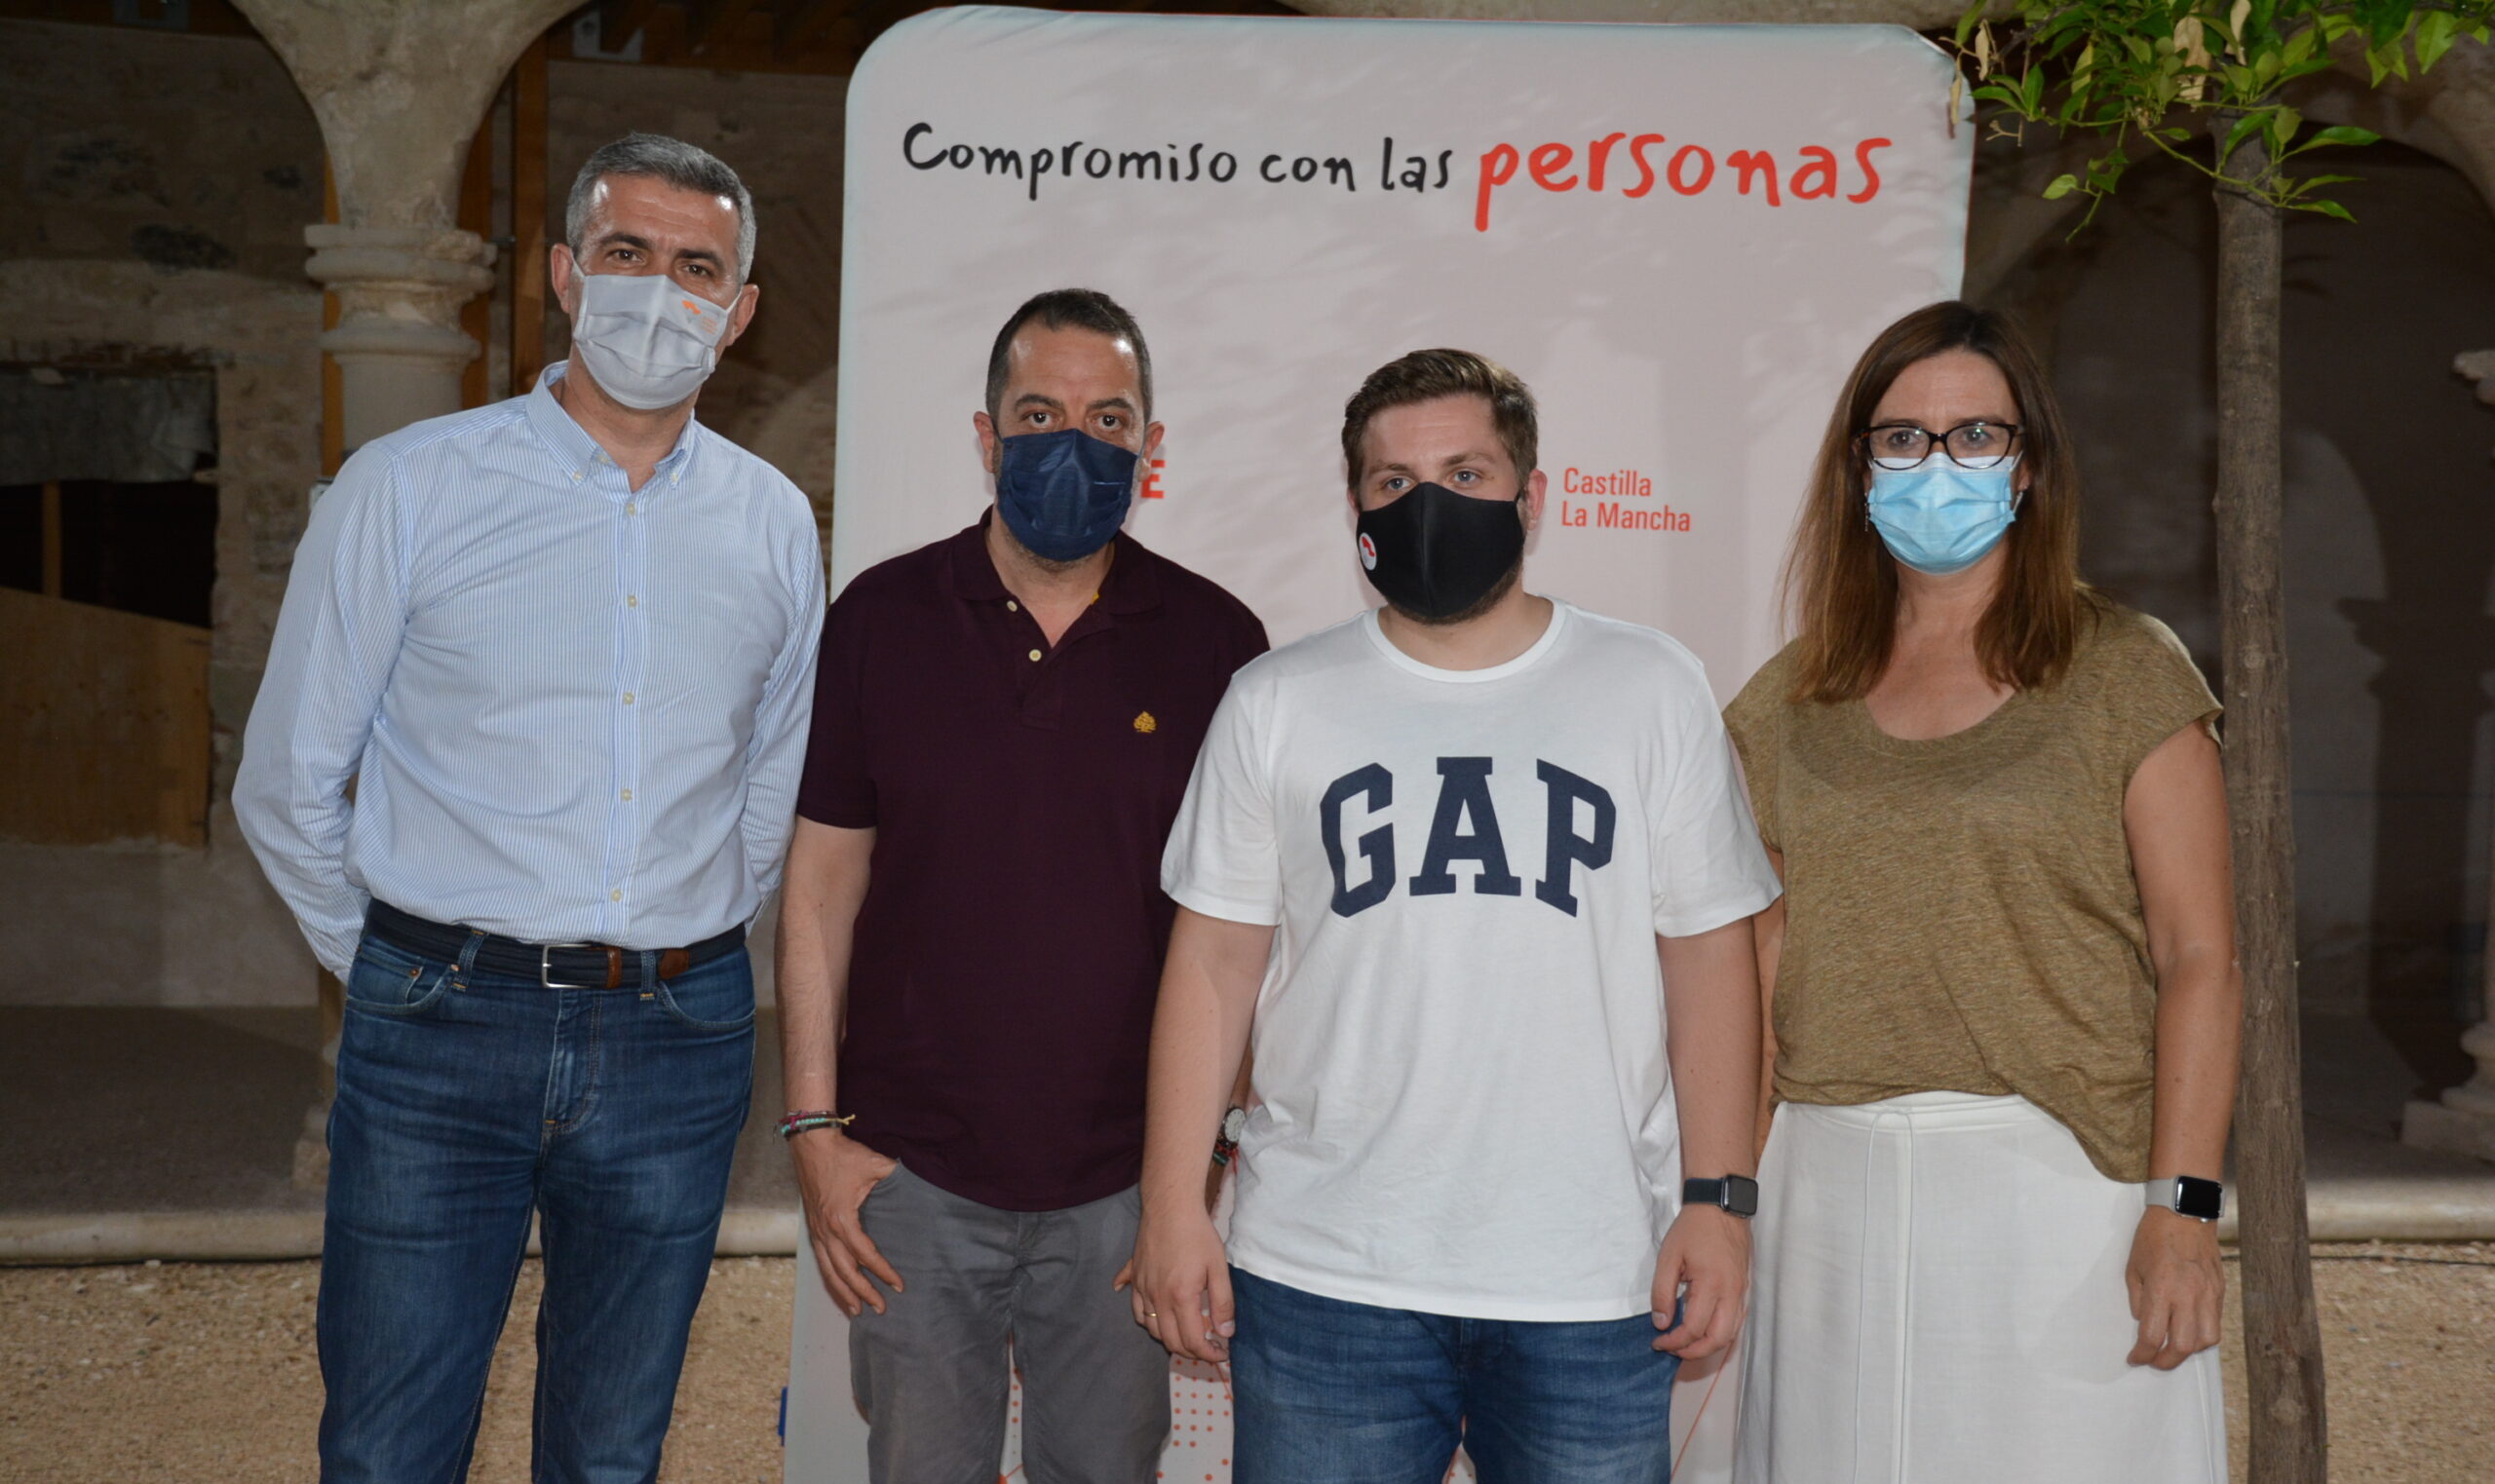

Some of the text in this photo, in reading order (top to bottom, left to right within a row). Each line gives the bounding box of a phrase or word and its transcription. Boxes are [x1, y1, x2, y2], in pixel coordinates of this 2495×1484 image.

[902, 122, 1894, 233] Compromiso con las personas
[1560, 500, 1692, 532] La Mancha
[1563, 467, 1653, 498] Castilla
[1320, 756, 1617, 918] GAP
